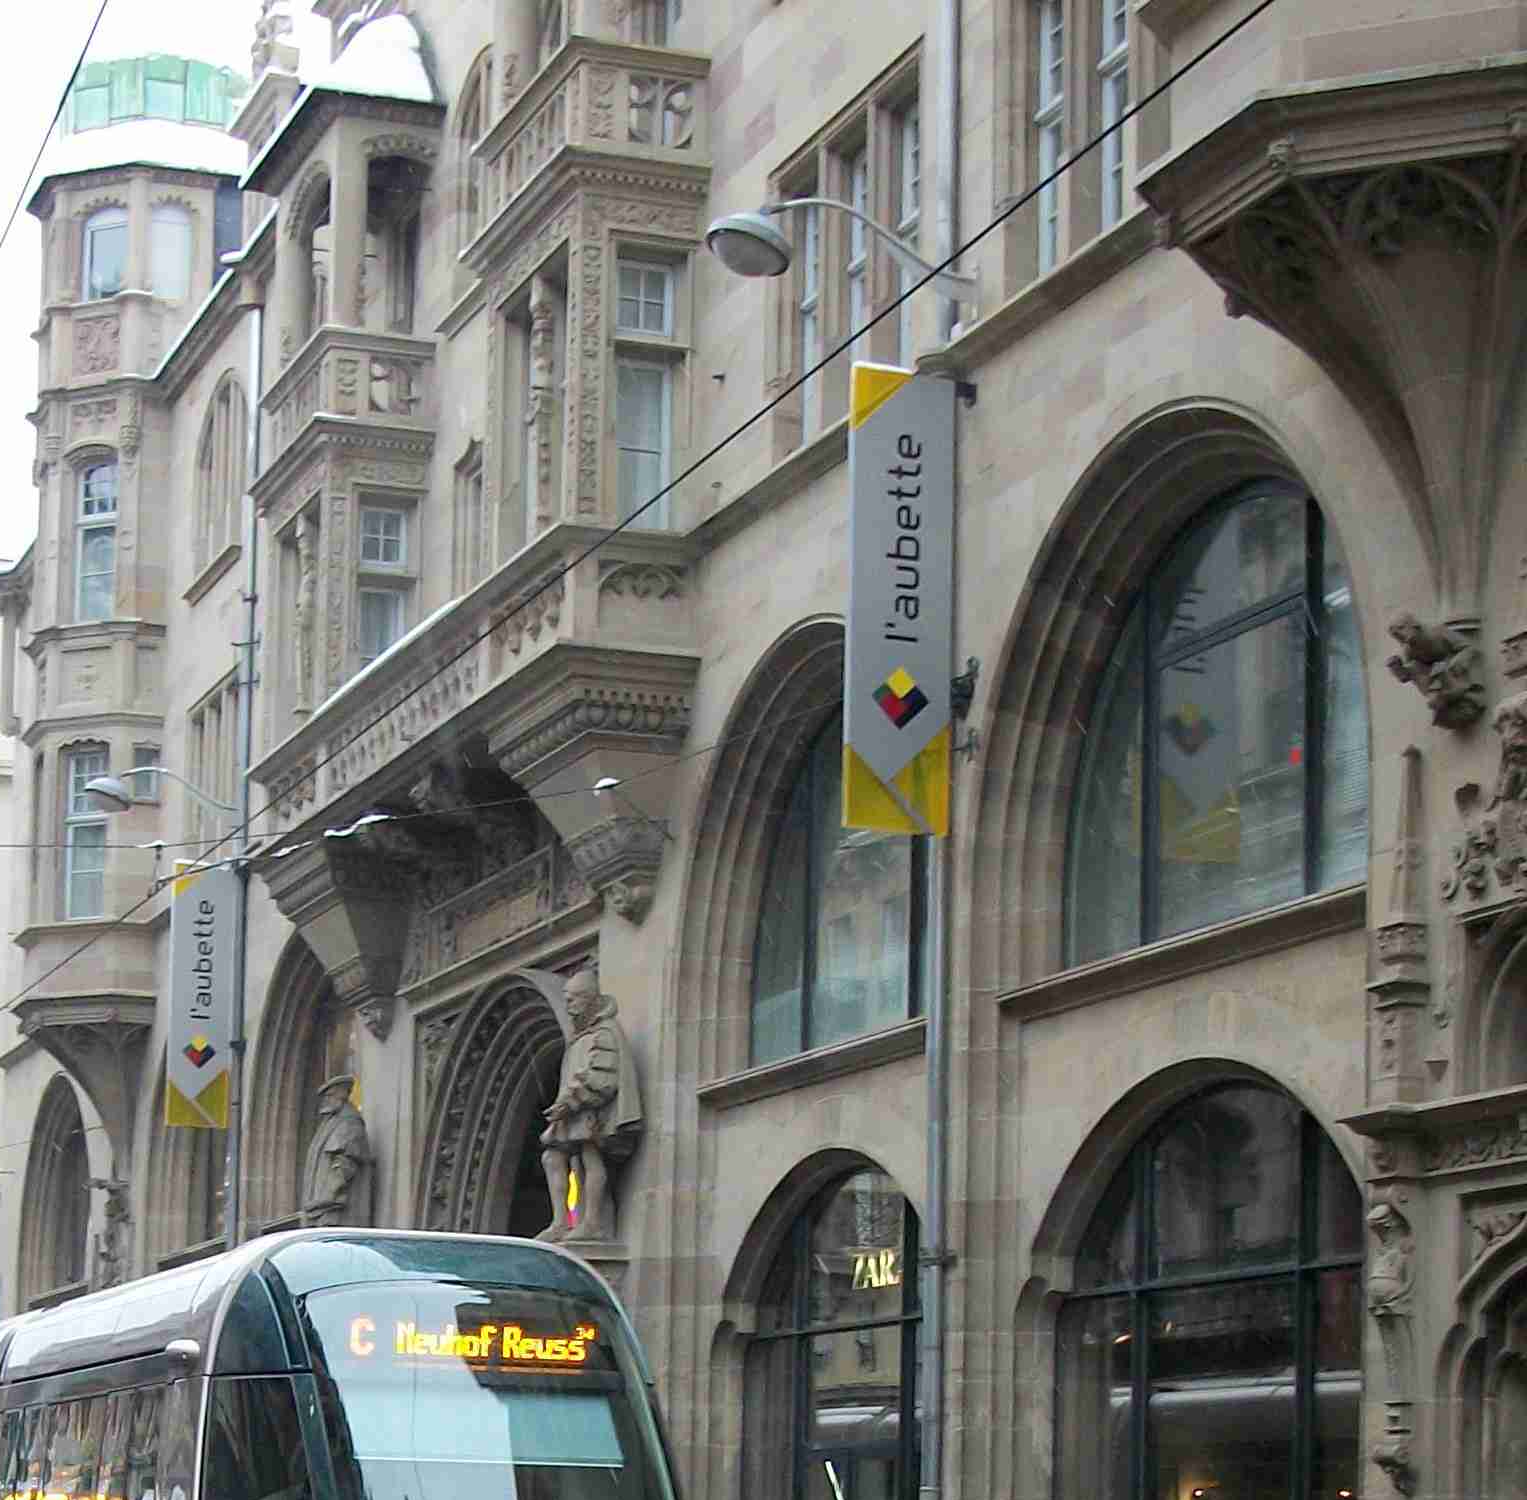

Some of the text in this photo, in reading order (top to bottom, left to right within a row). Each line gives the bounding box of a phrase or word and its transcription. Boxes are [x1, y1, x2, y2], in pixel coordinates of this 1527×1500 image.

[883, 433, 924, 644] l'aubette
[189, 898, 216, 1021] l'aubette
[348, 1318, 375, 1357] C
[395, 1320, 498, 1358] Neuhof
[501, 1325, 586, 1362] Reuss
